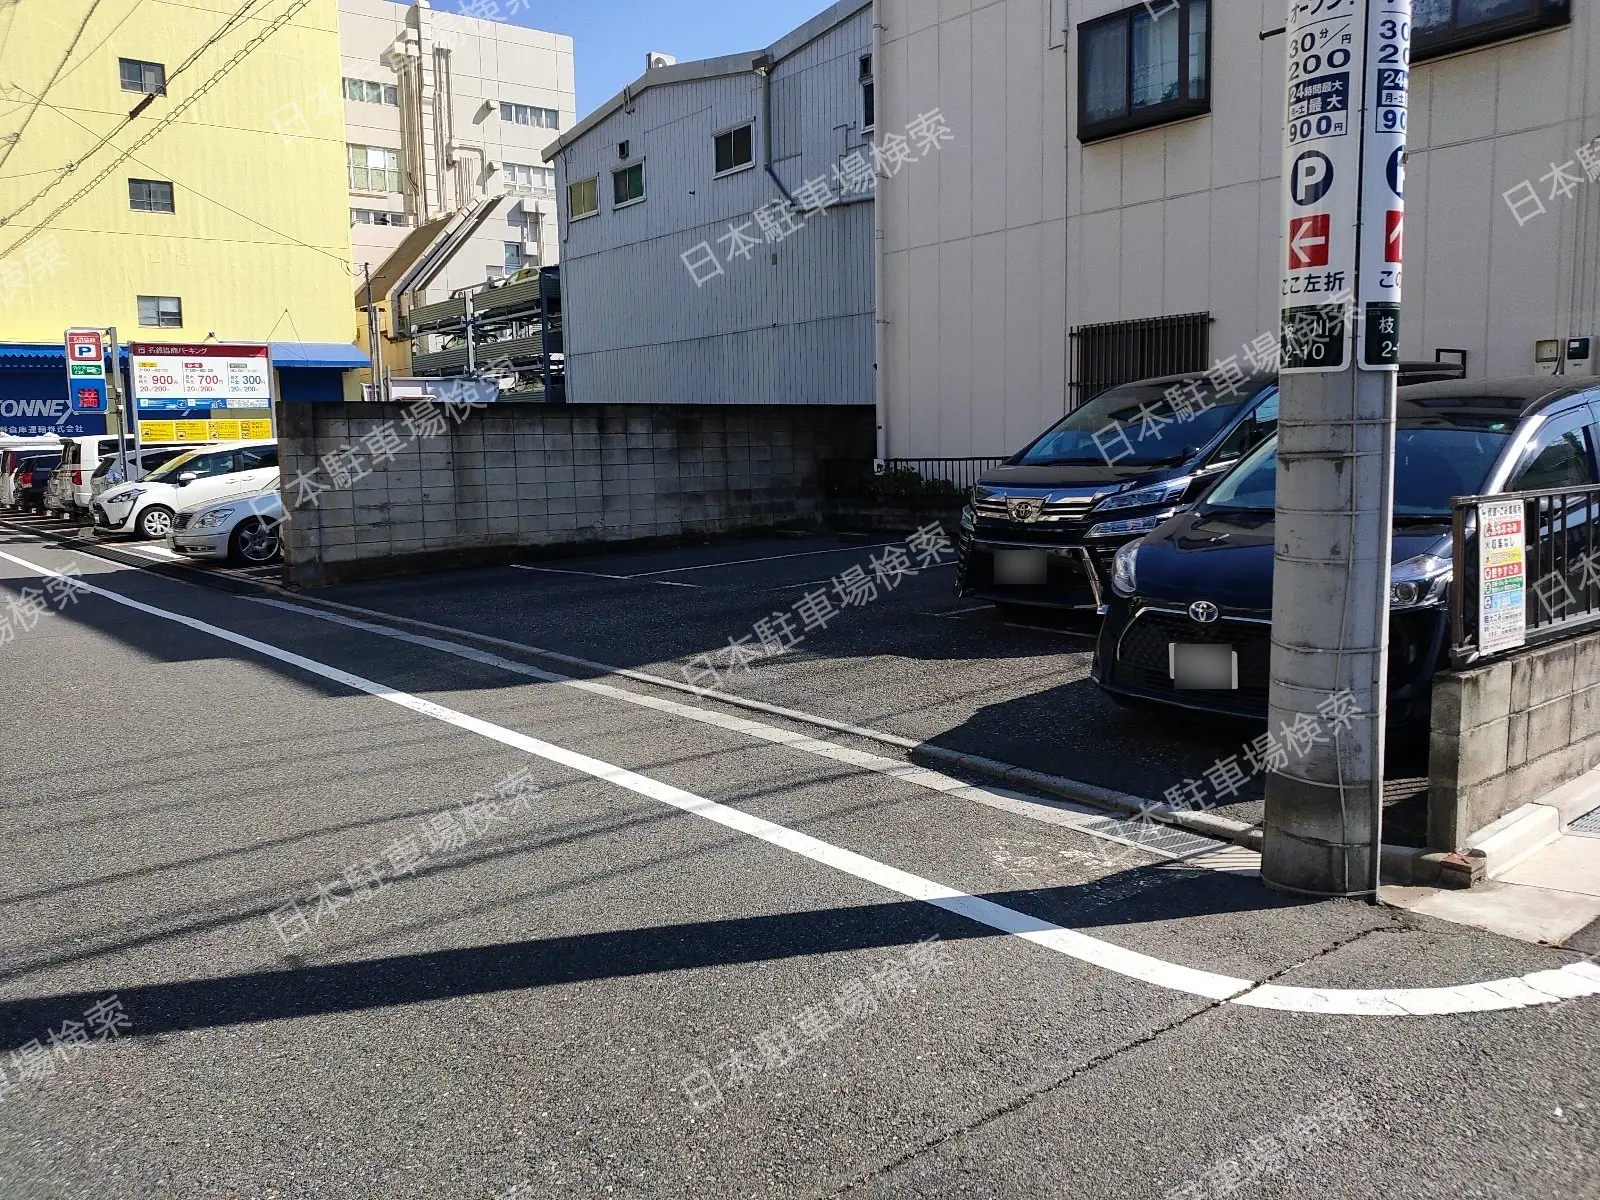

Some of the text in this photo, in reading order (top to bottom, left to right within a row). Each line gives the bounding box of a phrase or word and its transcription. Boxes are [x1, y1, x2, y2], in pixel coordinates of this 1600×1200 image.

[1289, 48, 1351, 82] 200
[1383, 71, 1407, 90] 24
[1290, 79, 1343, 103] 24時間最大
[1309, 94, 1343, 113] 最大
[1296, 156, 1327, 201] P
[1379, 316, 1395, 334] 枝
[79, 346, 92, 356] P
[1285, 343, 1324, 361] 2-10
[0, 400, 79, 425] ONNEX
